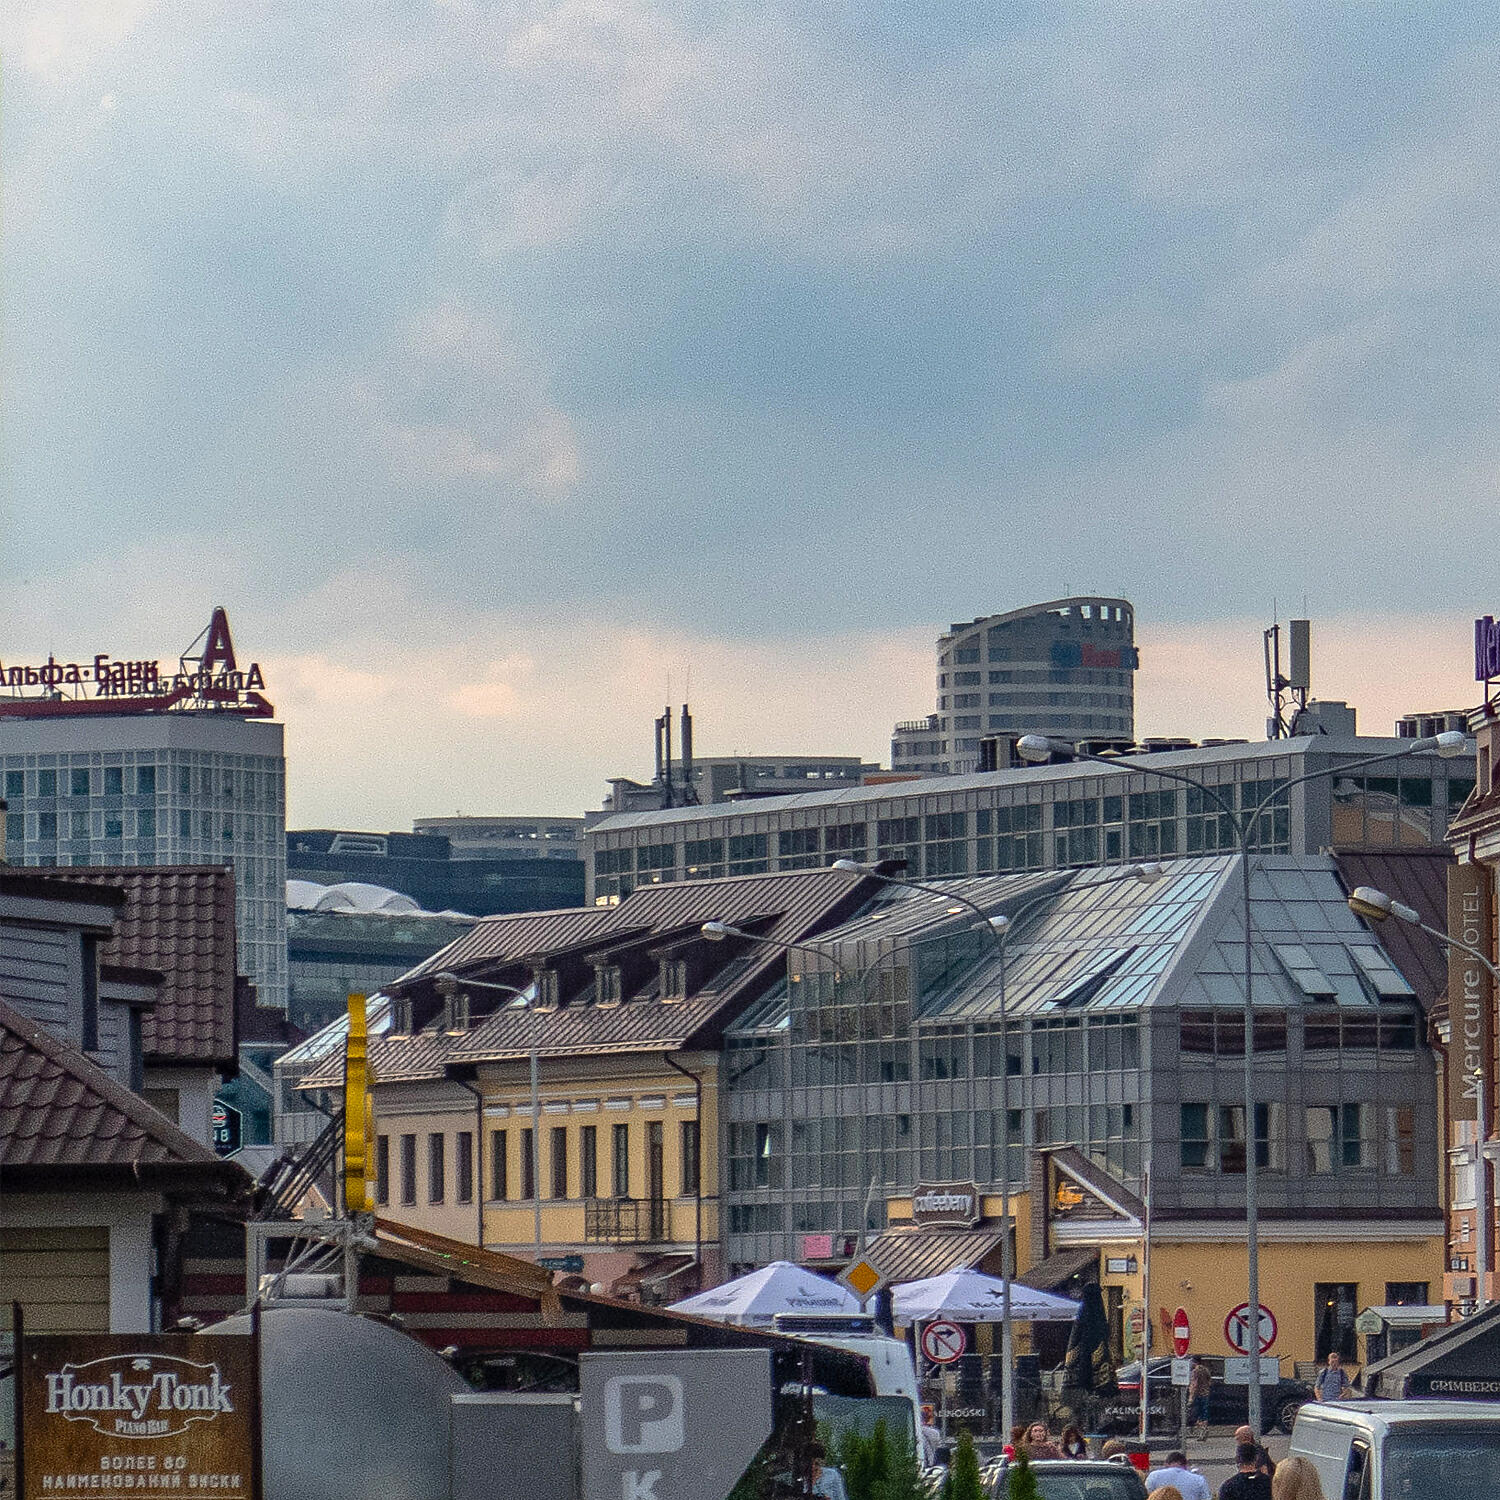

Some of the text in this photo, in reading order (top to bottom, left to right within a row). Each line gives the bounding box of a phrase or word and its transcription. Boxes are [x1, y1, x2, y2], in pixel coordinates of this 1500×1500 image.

[1461, 967, 1481, 1100] Mercure
[44, 1372, 234, 1420] Honky Tonk
[1104, 1405, 1166, 1416] KALINOSKI
[619, 1382, 674, 1447] P
[100, 1455, 157, 1470] БОЛЕЕ
[42, 1471, 243, 1489] НАИМЕНОВАНИЙ ВИСКИ
